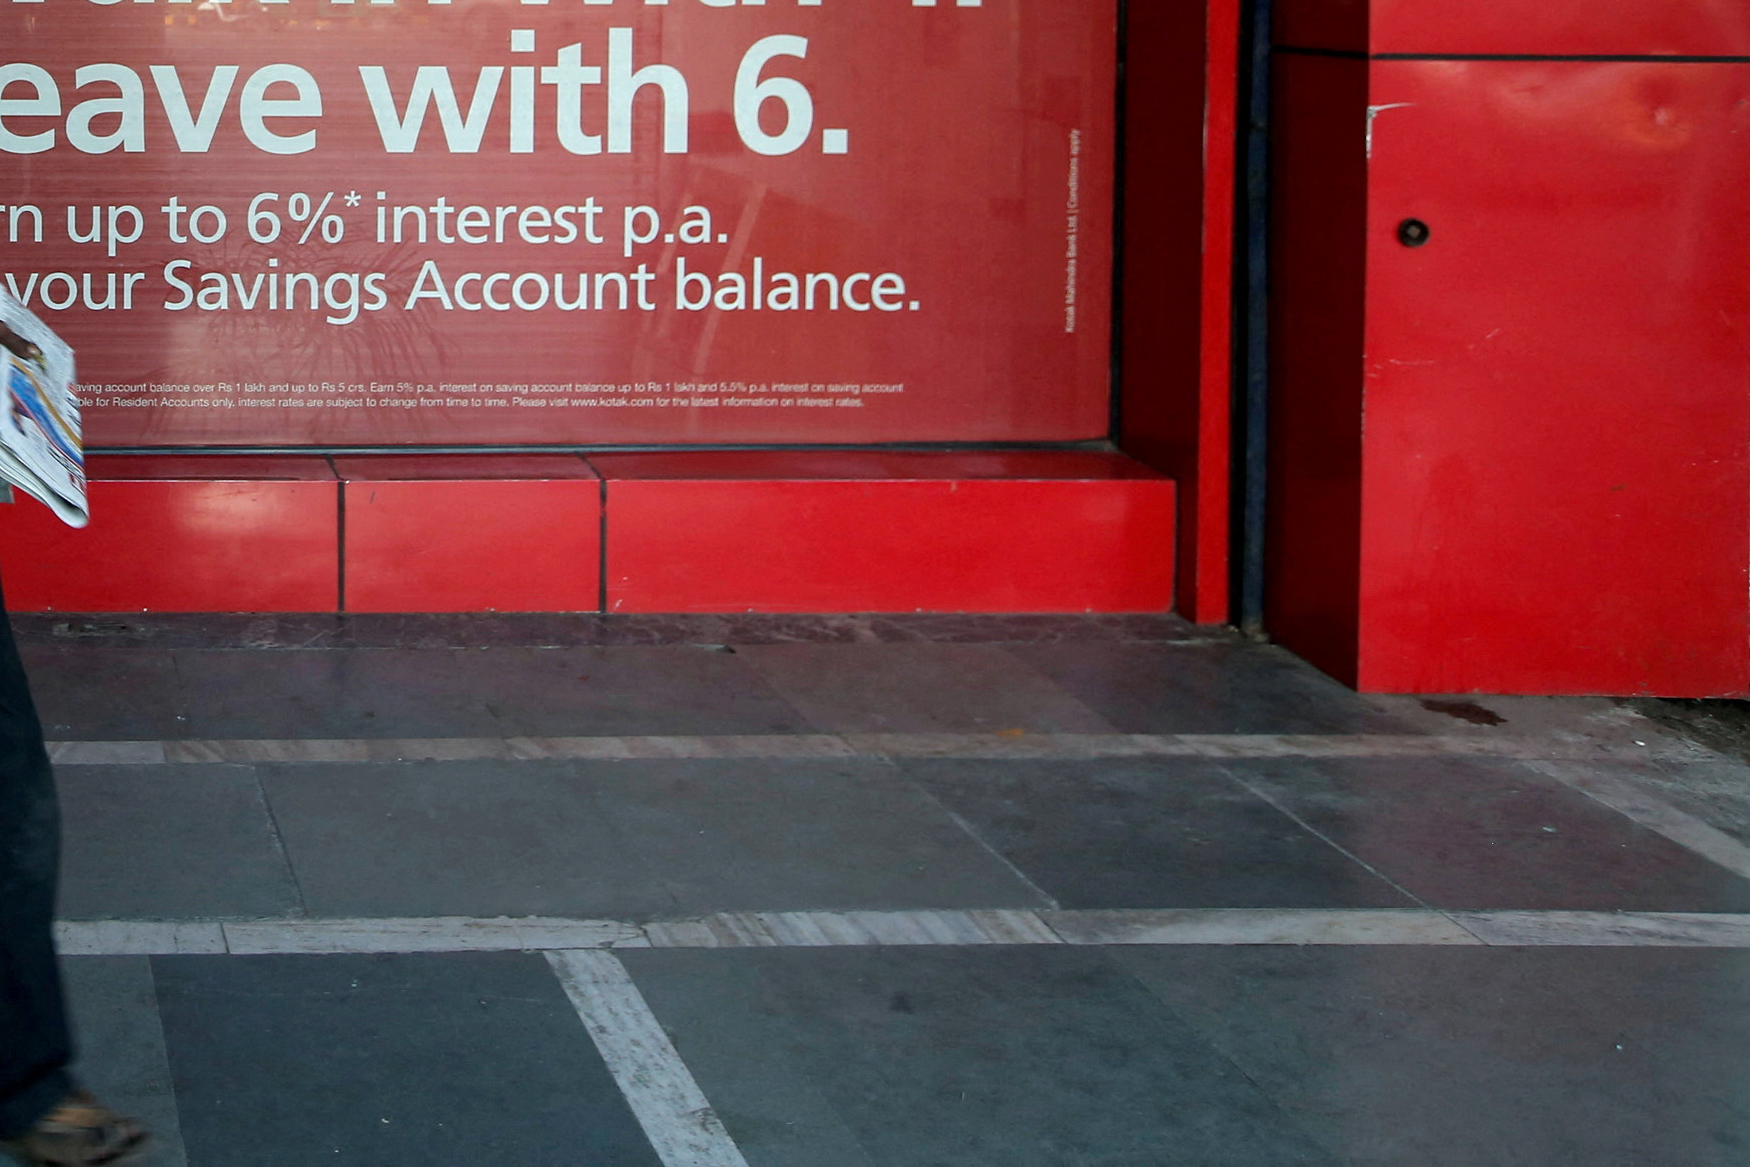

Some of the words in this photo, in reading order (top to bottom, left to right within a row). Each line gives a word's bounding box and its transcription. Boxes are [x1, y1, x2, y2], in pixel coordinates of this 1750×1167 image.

[358, 27, 689, 155] with
[732, 34, 849, 156] 6.
[67, 204, 145, 257] up
[161, 195, 228, 244] to
[376, 190, 604, 244] interest
[623, 204, 728, 257] p.a.
[163, 258, 387, 326] Savings
[404, 259, 656, 312] Account
[675, 256, 921, 312] balance.
[76, 382, 102, 394] aving
[104, 382, 147, 392] account
[150, 382, 190, 392] balance
[192, 382, 215, 392] over
[218, 382, 232, 392] Rs
[236, 382, 240, 392] 1
[244, 382, 266, 392] lakh
[269, 382, 289, 392] and
[292, 382, 305, 394] up
[308, 382, 318, 392] to
[321, 382, 336, 392] Rs
[370, 382, 394, 392] Earn
[440, 382, 476, 392] interest
[480, 382, 493, 392] on
[495, 382, 528, 394] saving
[531, 382, 572, 392] account
[575, 382, 615, 392] balance
[618, 382, 631, 394] up
[634, 382, 646, 392] to
[648, 382, 662, 392] Rs
[697, 382, 718, 392] and
[771, 382, 808, 392] interest
[810, 382, 825, 392] on
[826, 382, 860, 394] saving
[862, 382, 904, 392] account
[96, 397, 110, 406] for
[112, 397, 158, 406] Resident
[160, 397, 209, 406] Accounts
[238, 397, 276, 406] interest
[278, 397, 304, 406] rates
[307, 397, 324, 406] are
[326, 397, 363, 408] subject
[366, 397, 376, 406] to
[379, 397, 418, 408] change
[420, 397, 444, 406] from
[446, 397, 468, 406] time
[472, 397, 482, 406] to
[512, 397, 547, 406] Please
[549, 397, 568, 406] visit
[571, 397, 654, 406] www.kotak.com
[656, 397, 670, 406] for
[672, 397, 690, 406] the
[690, 397, 719, 406] latest
[722, 397, 779, 406] information
[780, 397, 794, 406] on
[796, 397, 834, 406] interest
